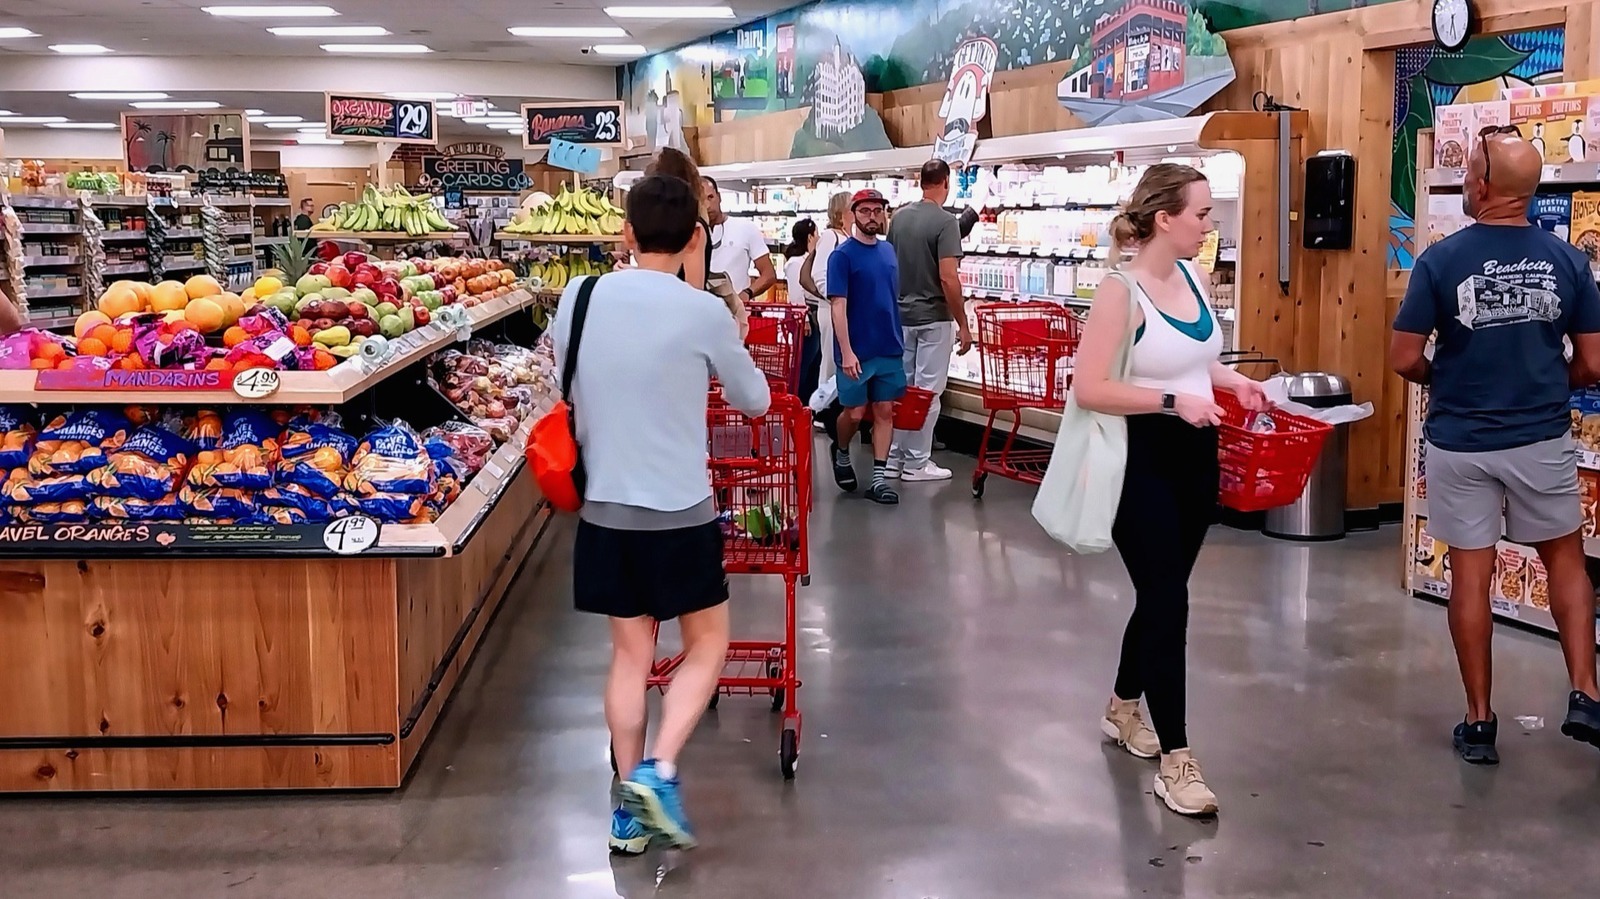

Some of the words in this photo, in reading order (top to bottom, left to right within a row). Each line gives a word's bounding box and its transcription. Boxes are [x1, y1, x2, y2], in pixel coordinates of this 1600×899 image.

[736, 28, 764, 57] Dairy
[331, 99, 395, 121] ORGANIC
[455, 102, 475, 116] EXIT
[1514, 103, 1542, 117] PUFFINS
[1551, 99, 1582, 114] PUFFINS
[332, 116, 388, 131] Bananas
[399, 103, 428, 135] 29
[531, 113, 595, 140] Bananas
[595, 110, 617, 140] 23
[434, 160, 510, 175] GREETING
[442, 173, 504, 187] CARDS
[1537, 199, 1569, 207] FROSTED
[1482, 257, 1555, 275] Beachcity
[104, 370, 220, 387] MANDARINS
[54, 525, 150, 542] ORANGES
